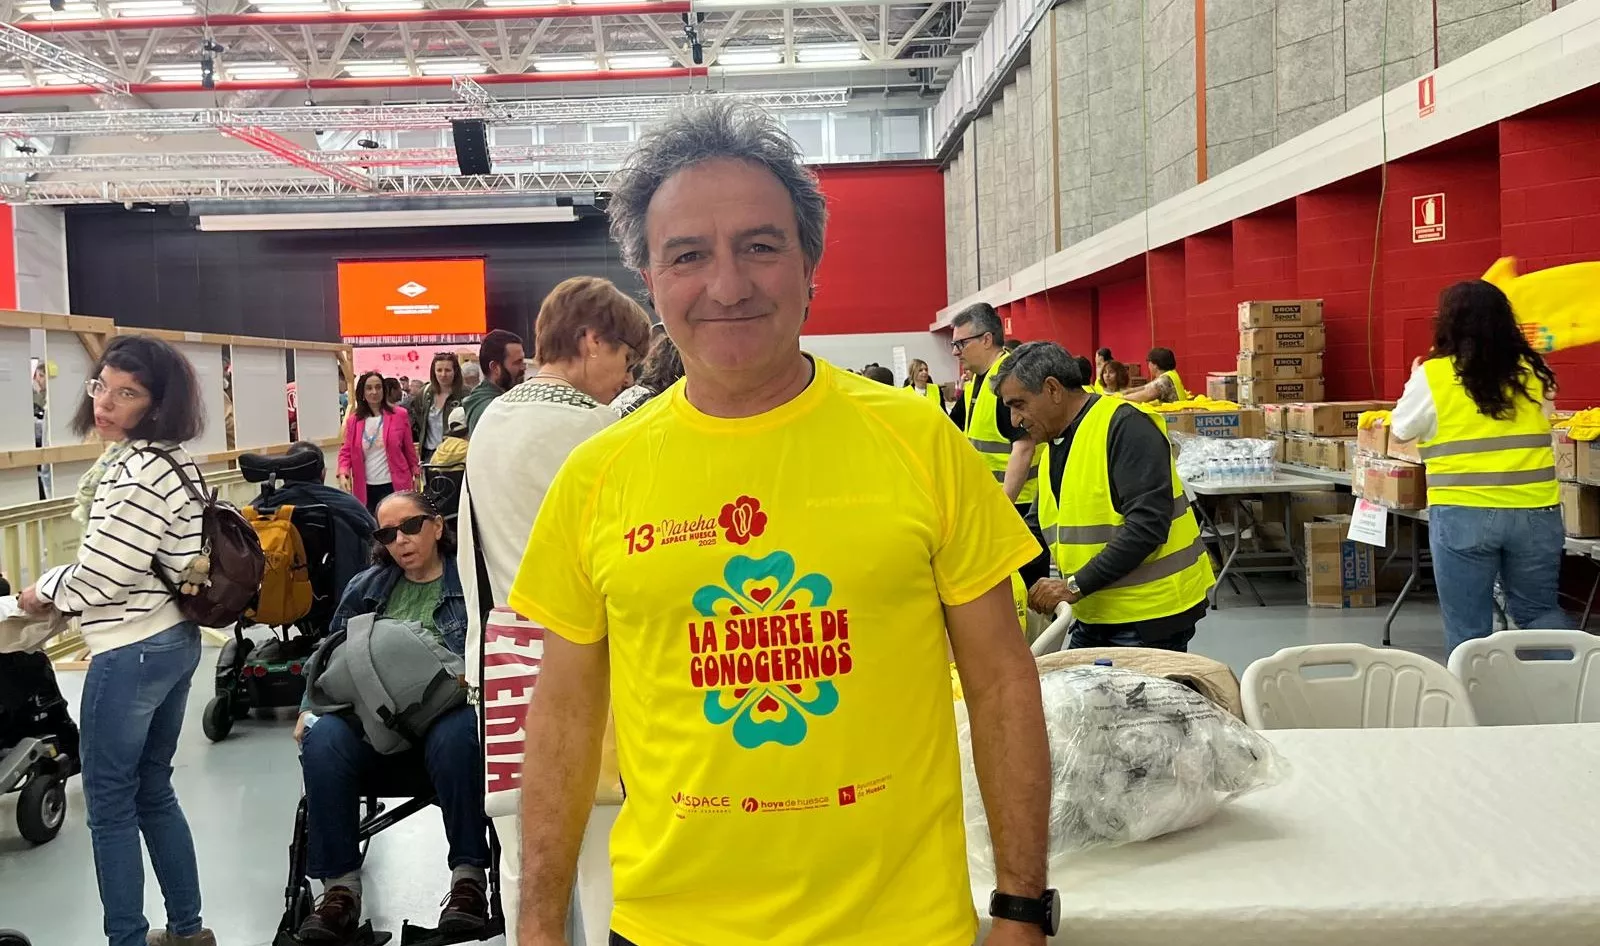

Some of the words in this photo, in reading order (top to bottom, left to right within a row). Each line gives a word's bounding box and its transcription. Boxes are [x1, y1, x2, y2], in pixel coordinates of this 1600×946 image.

[1205, 415, 1237, 426] ROLY
[1197, 427, 1231, 437] Sport
[661, 514, 718, 537] Marcha
[660, 534, 687, 546] ASPACE
[689, 530, 718, 541] HUESCA
[698, 538, 717, 547] 2025
[688, 620, 718, 654] LA
[725, 611, 814, 651] SUERTE
[820, 608, 849, 642] DE
[690, 642, 853, 688] CONOCERNOS
[760, 800, 784, 809] hoya
[796, 796, 829, 806] huesca
